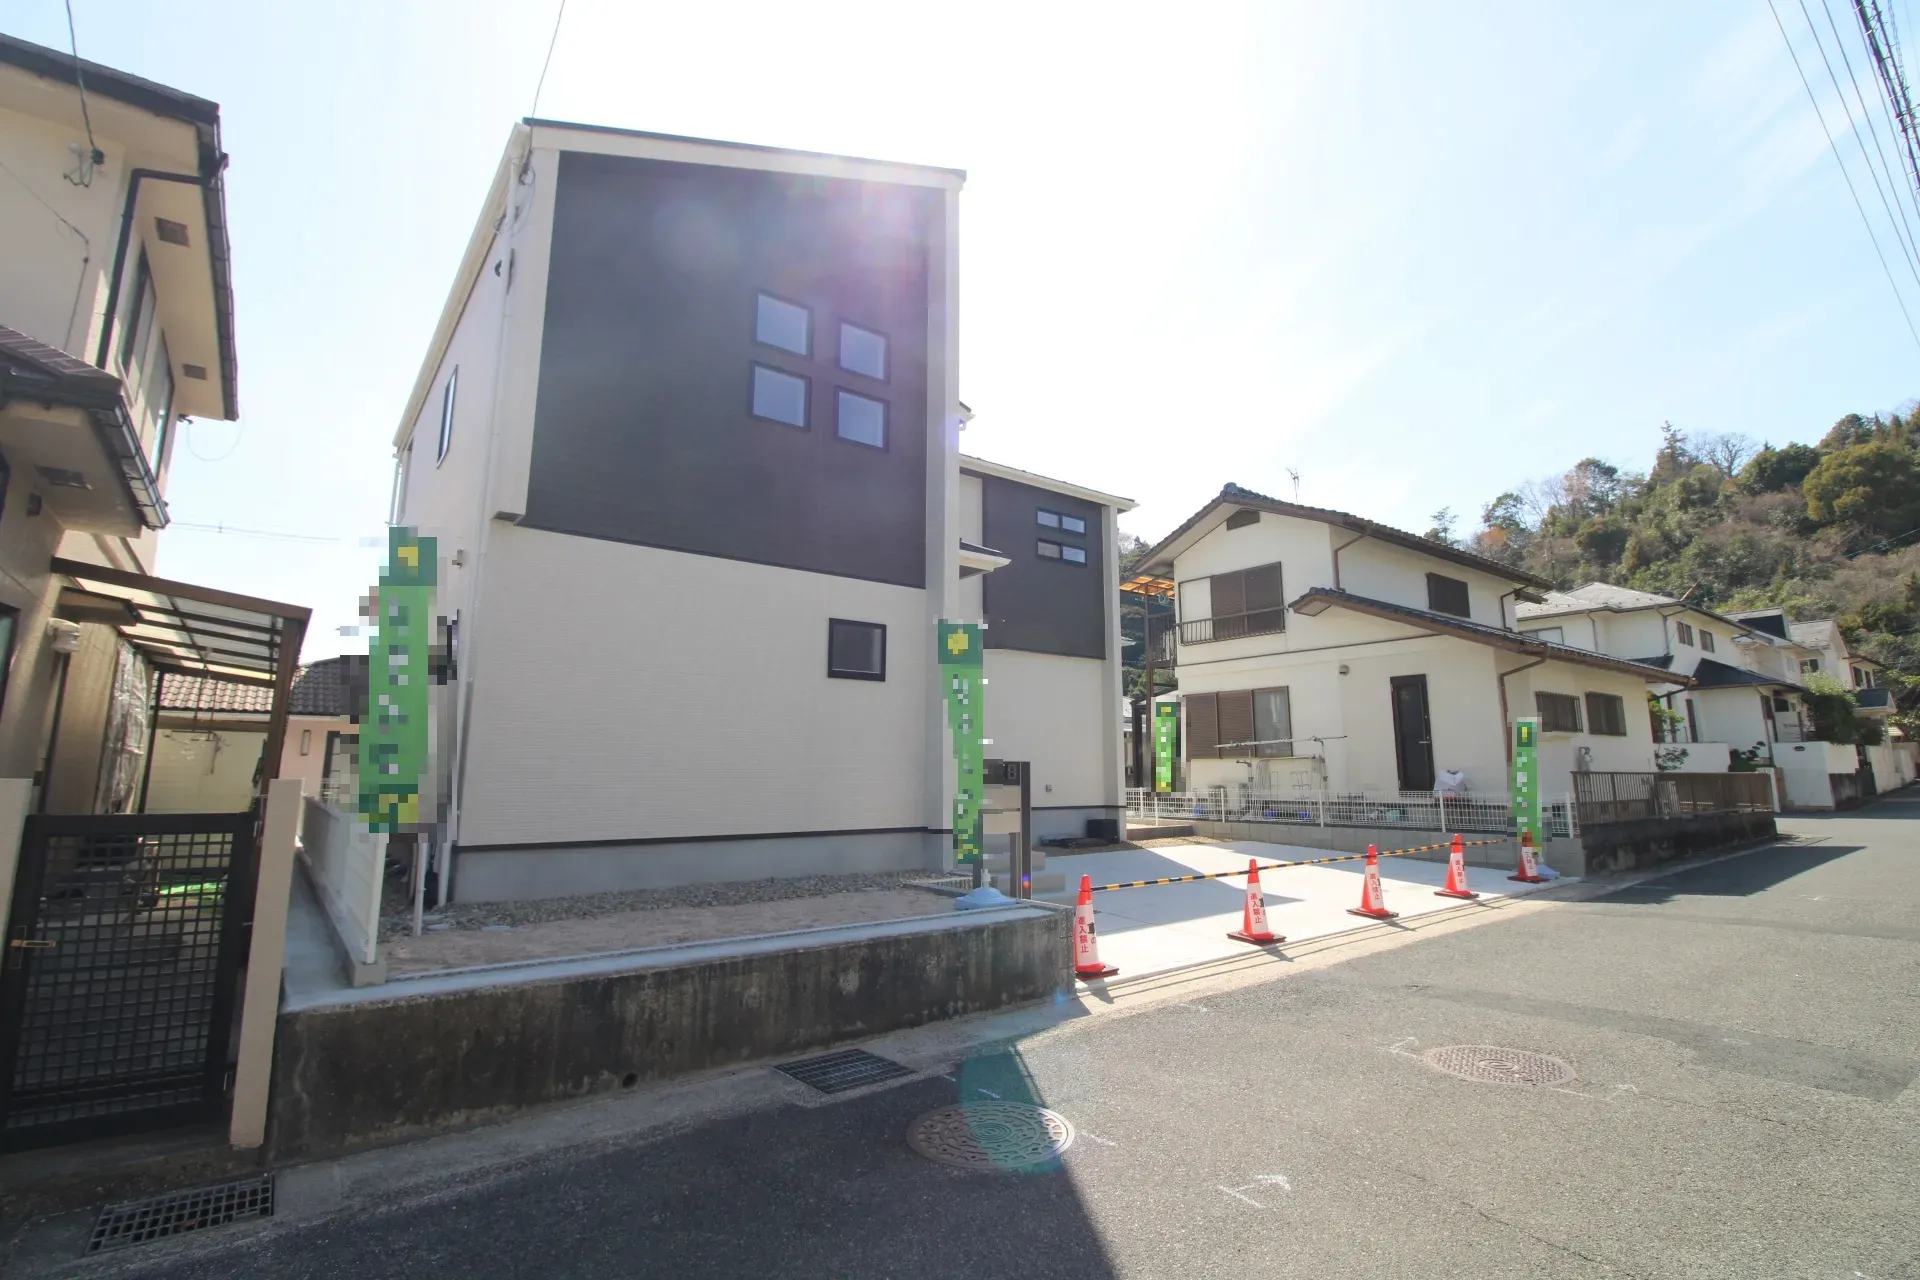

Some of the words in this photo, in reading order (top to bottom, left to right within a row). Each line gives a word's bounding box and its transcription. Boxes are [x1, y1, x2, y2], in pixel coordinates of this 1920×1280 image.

[1370, 873, 1380, 900] 進入禁止
[1250, 892, 1262, 924] 進入禁止
[1078, 916, 1090, 954] 進入禁止
